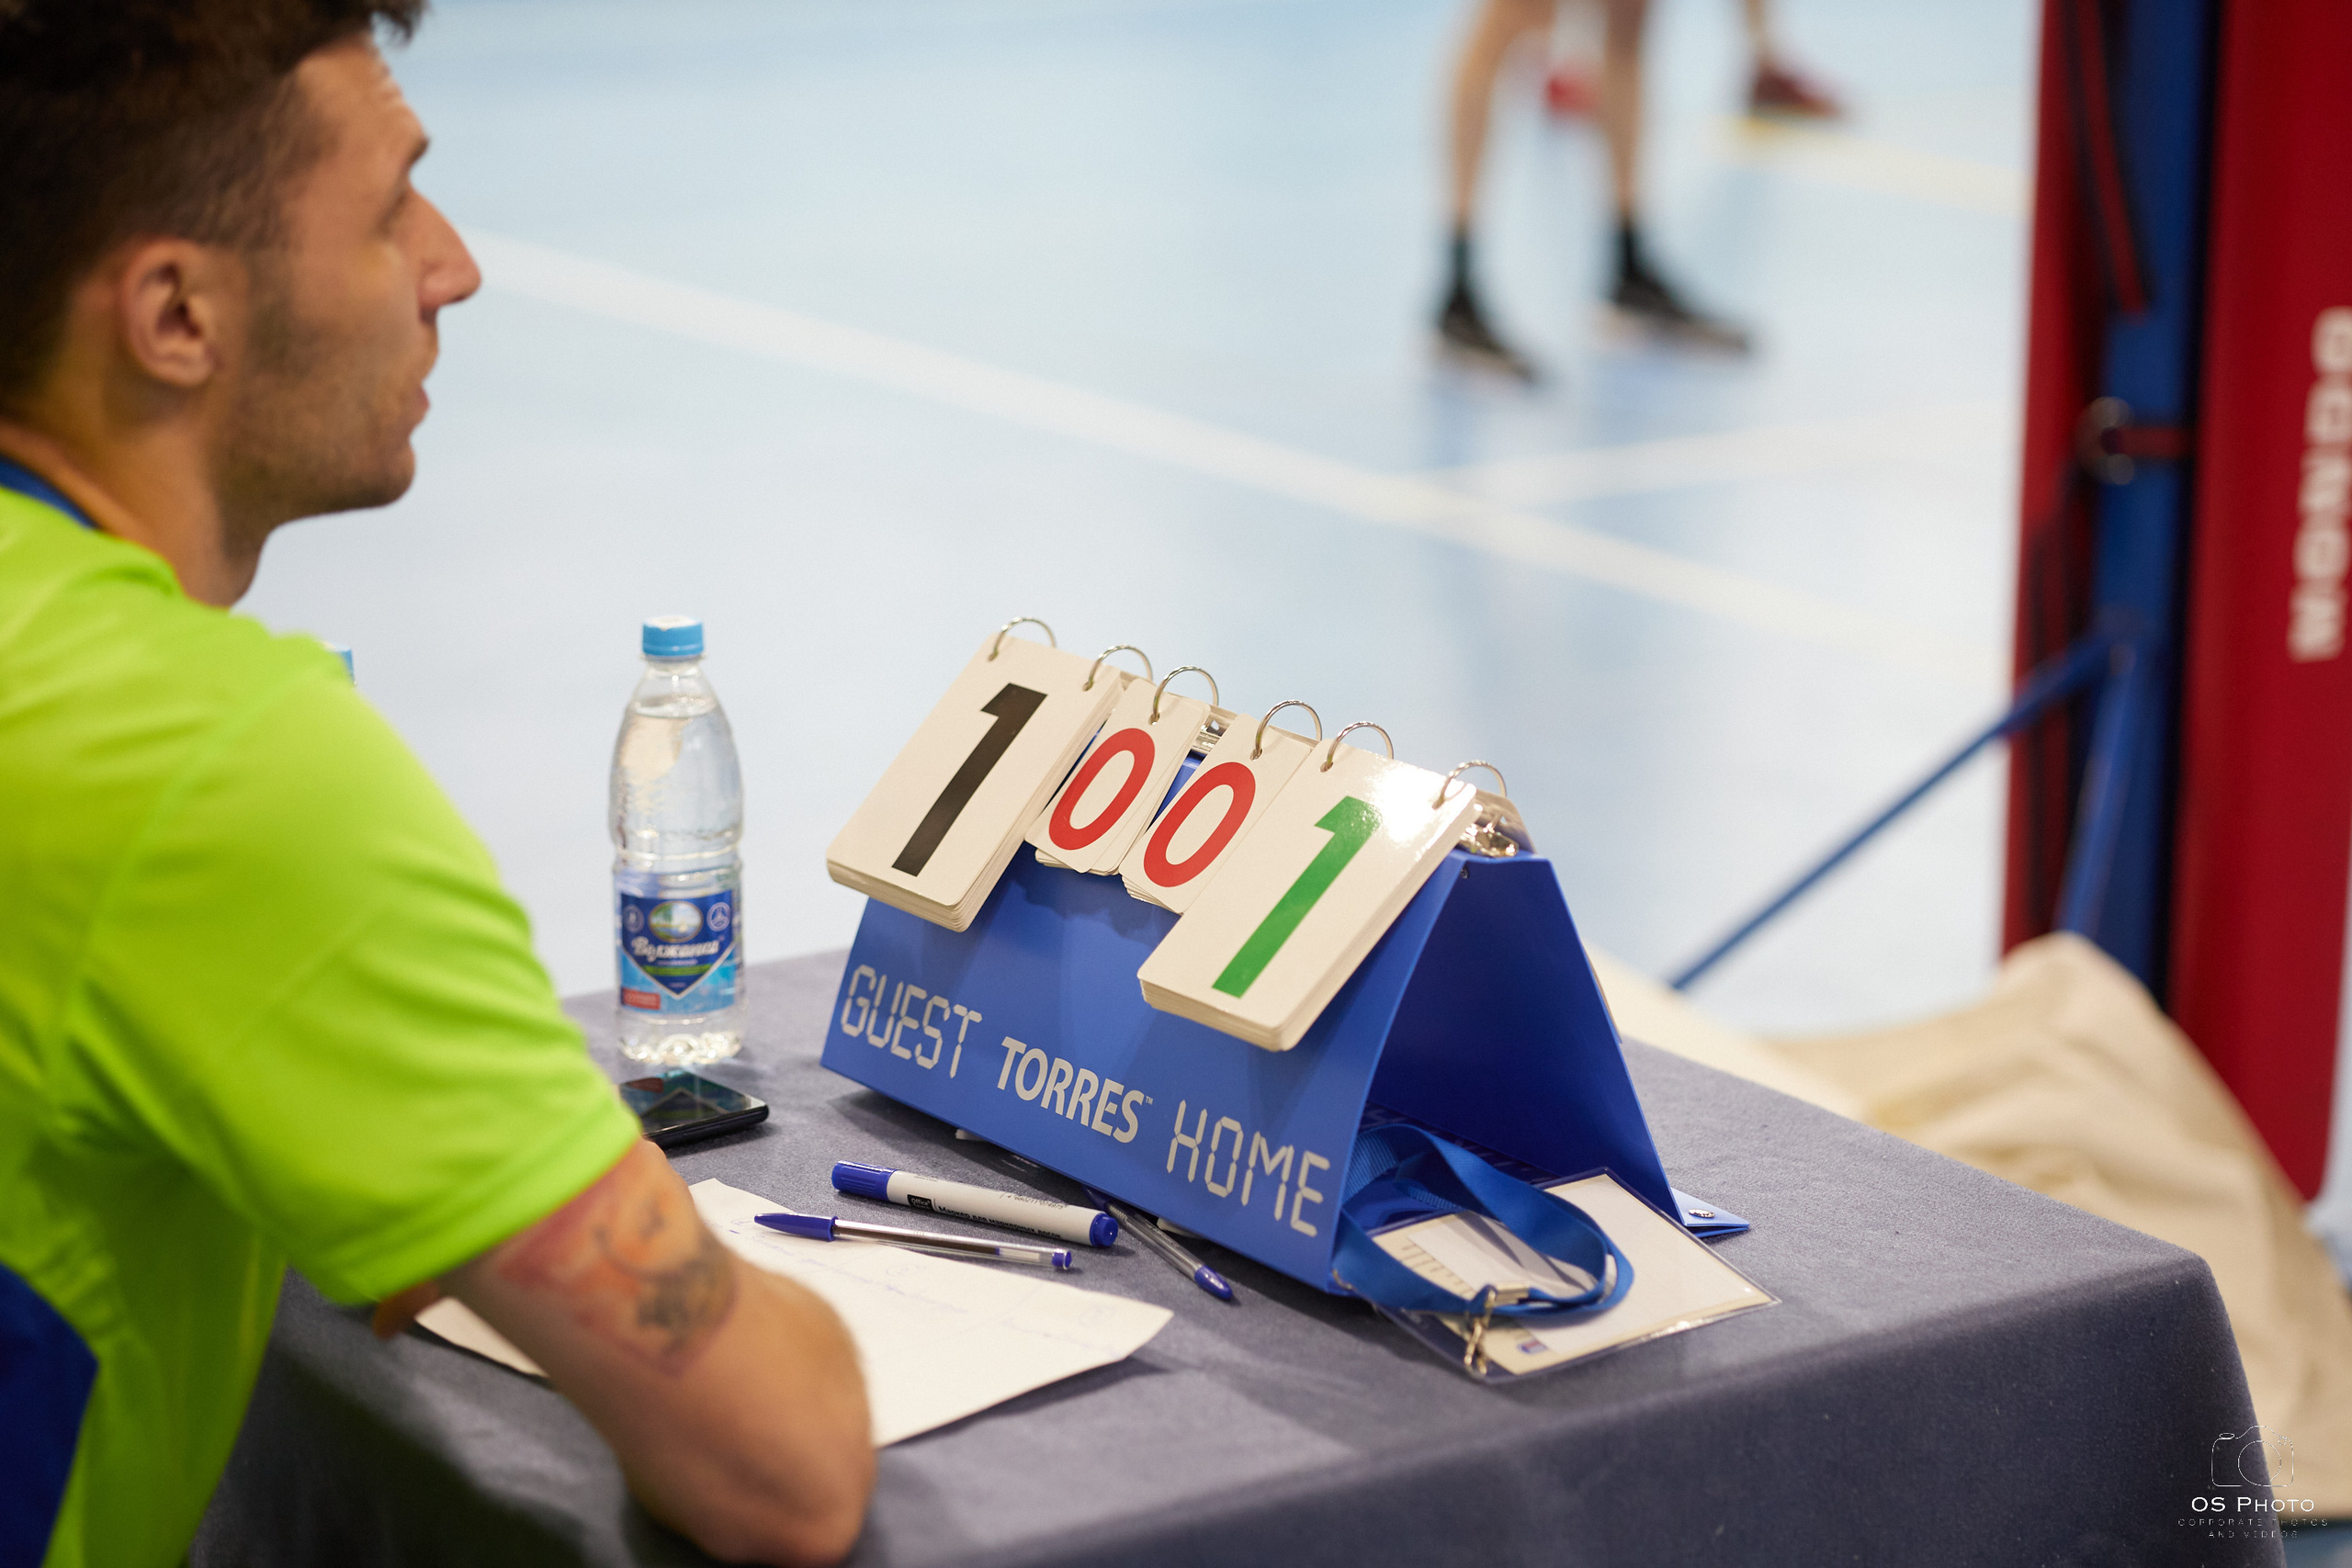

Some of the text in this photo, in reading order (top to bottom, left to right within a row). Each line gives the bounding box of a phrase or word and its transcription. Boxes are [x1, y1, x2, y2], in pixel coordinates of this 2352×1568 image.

[891, 682, 1381, 998] 1 0 0 1
[841, 964, 982, 1078] GUEST
[997, 1036, 1145, 1144] TORRES
[1167, 1100, 1330, 1237] HOME
